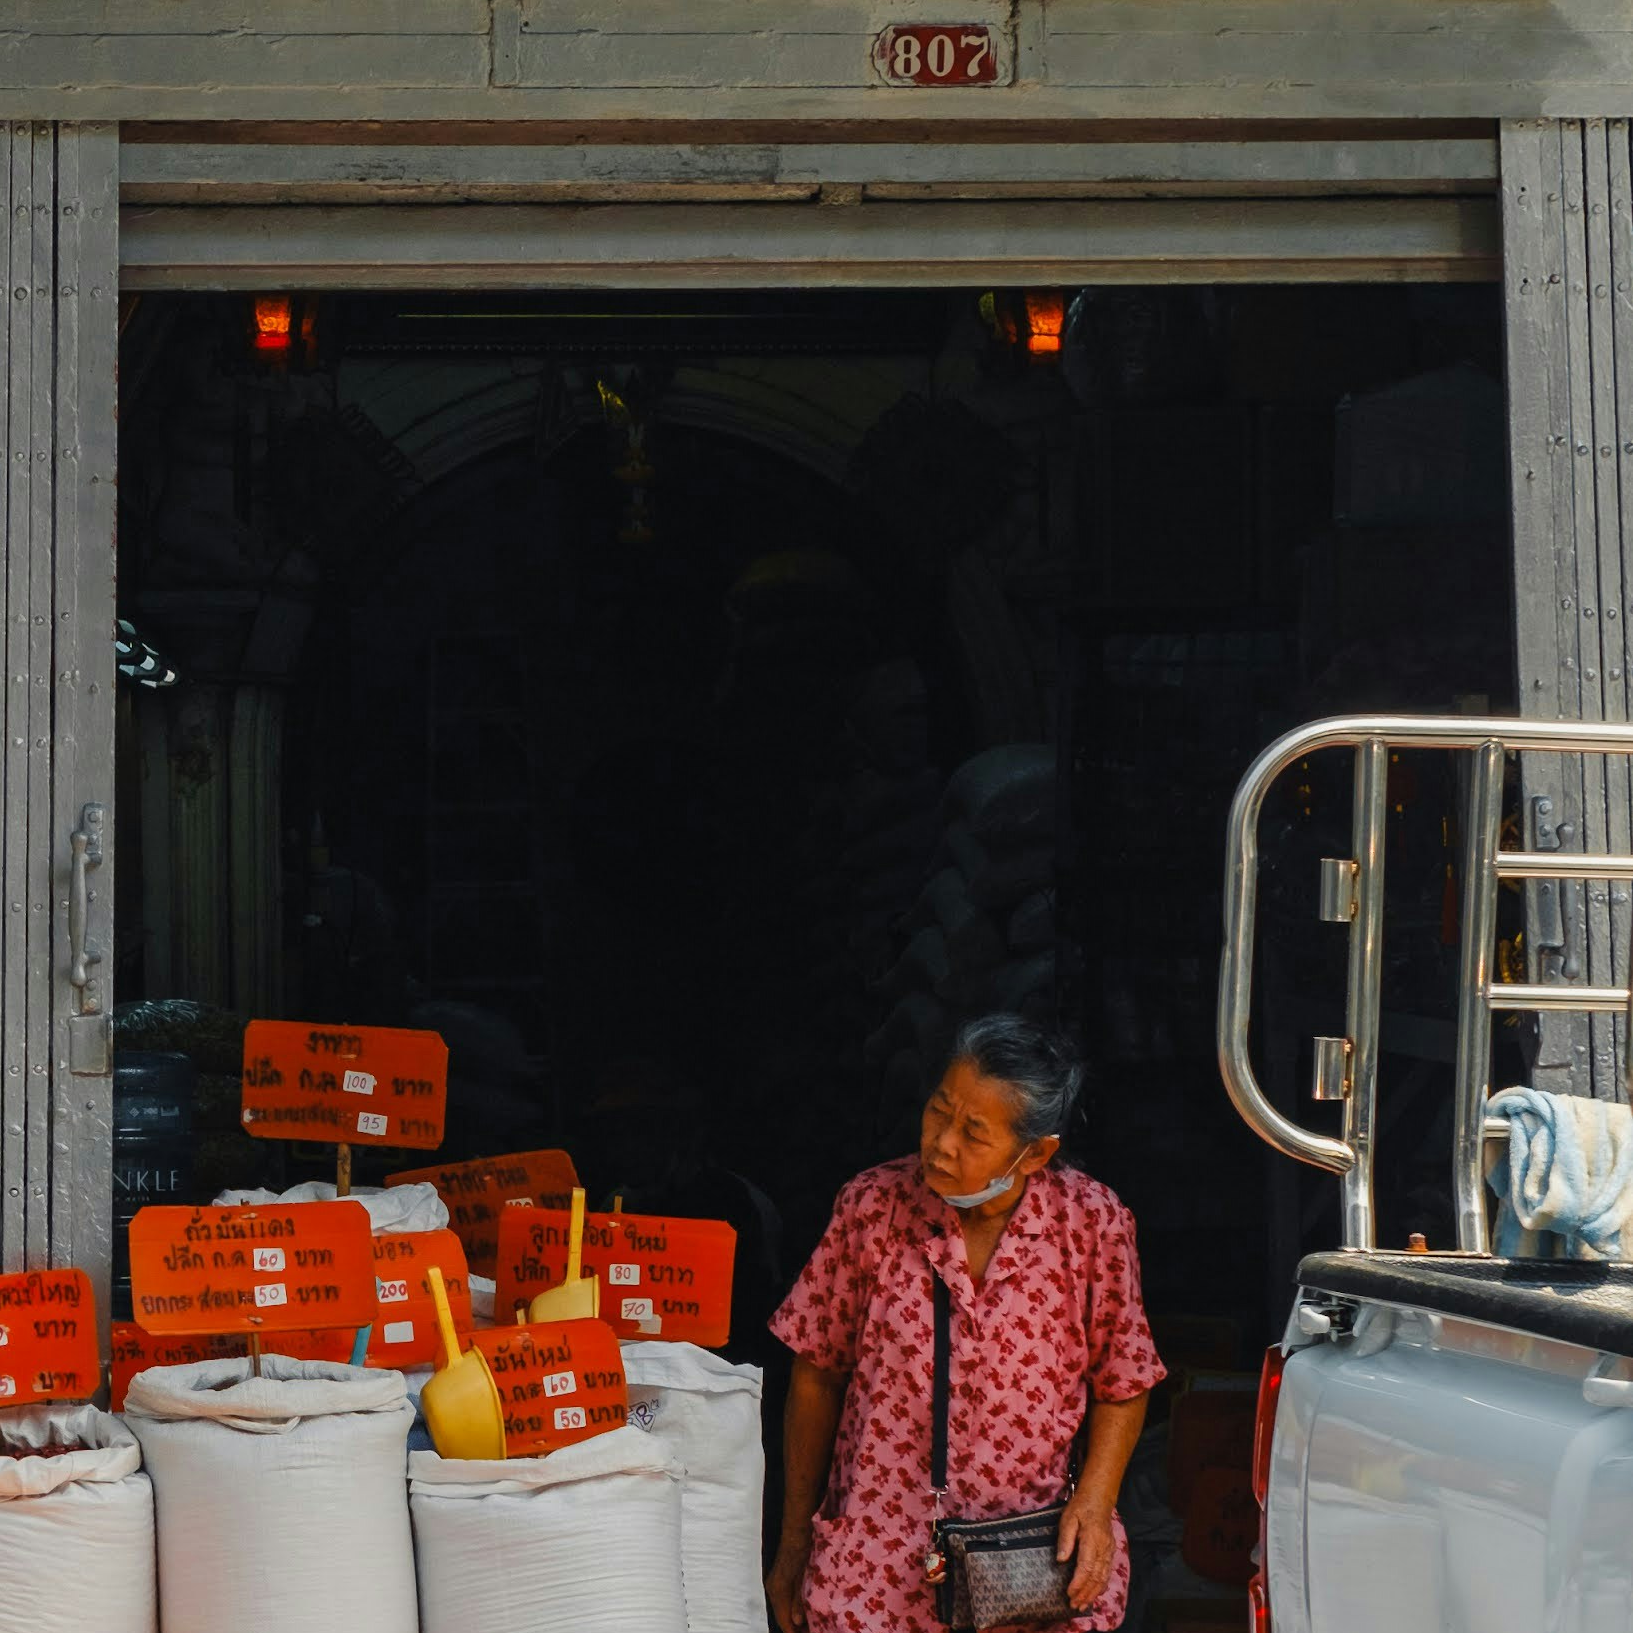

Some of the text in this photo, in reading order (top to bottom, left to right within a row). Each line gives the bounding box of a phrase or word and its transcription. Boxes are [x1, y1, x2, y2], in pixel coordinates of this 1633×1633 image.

[893, 34, 991, 78] 807
[346, 1075, 366, 1089] 100
[362, 1117, 380, 1129] 95
[259, 1252, 278, 1267] 60
[295, 1249, 333, 1268] บาท
[615, 1267, 631, 1279] 80
[259, 1290, 279, 1304] 50
[297, 1285, 340, 1302] บาท
[380, 1283, 406, 1299] 200
[624, 1302, 645, 1317] 70
[34, 1320, 77, 1339] บาท
[39, 1371, 77, 1389] บาท
[551, 1376, 569, 1394] 60
[584, 1371, 620, 1389] บาท
[560, 1411, 581, 1428] 50
[589, 1404, 626, 1424] บาท
